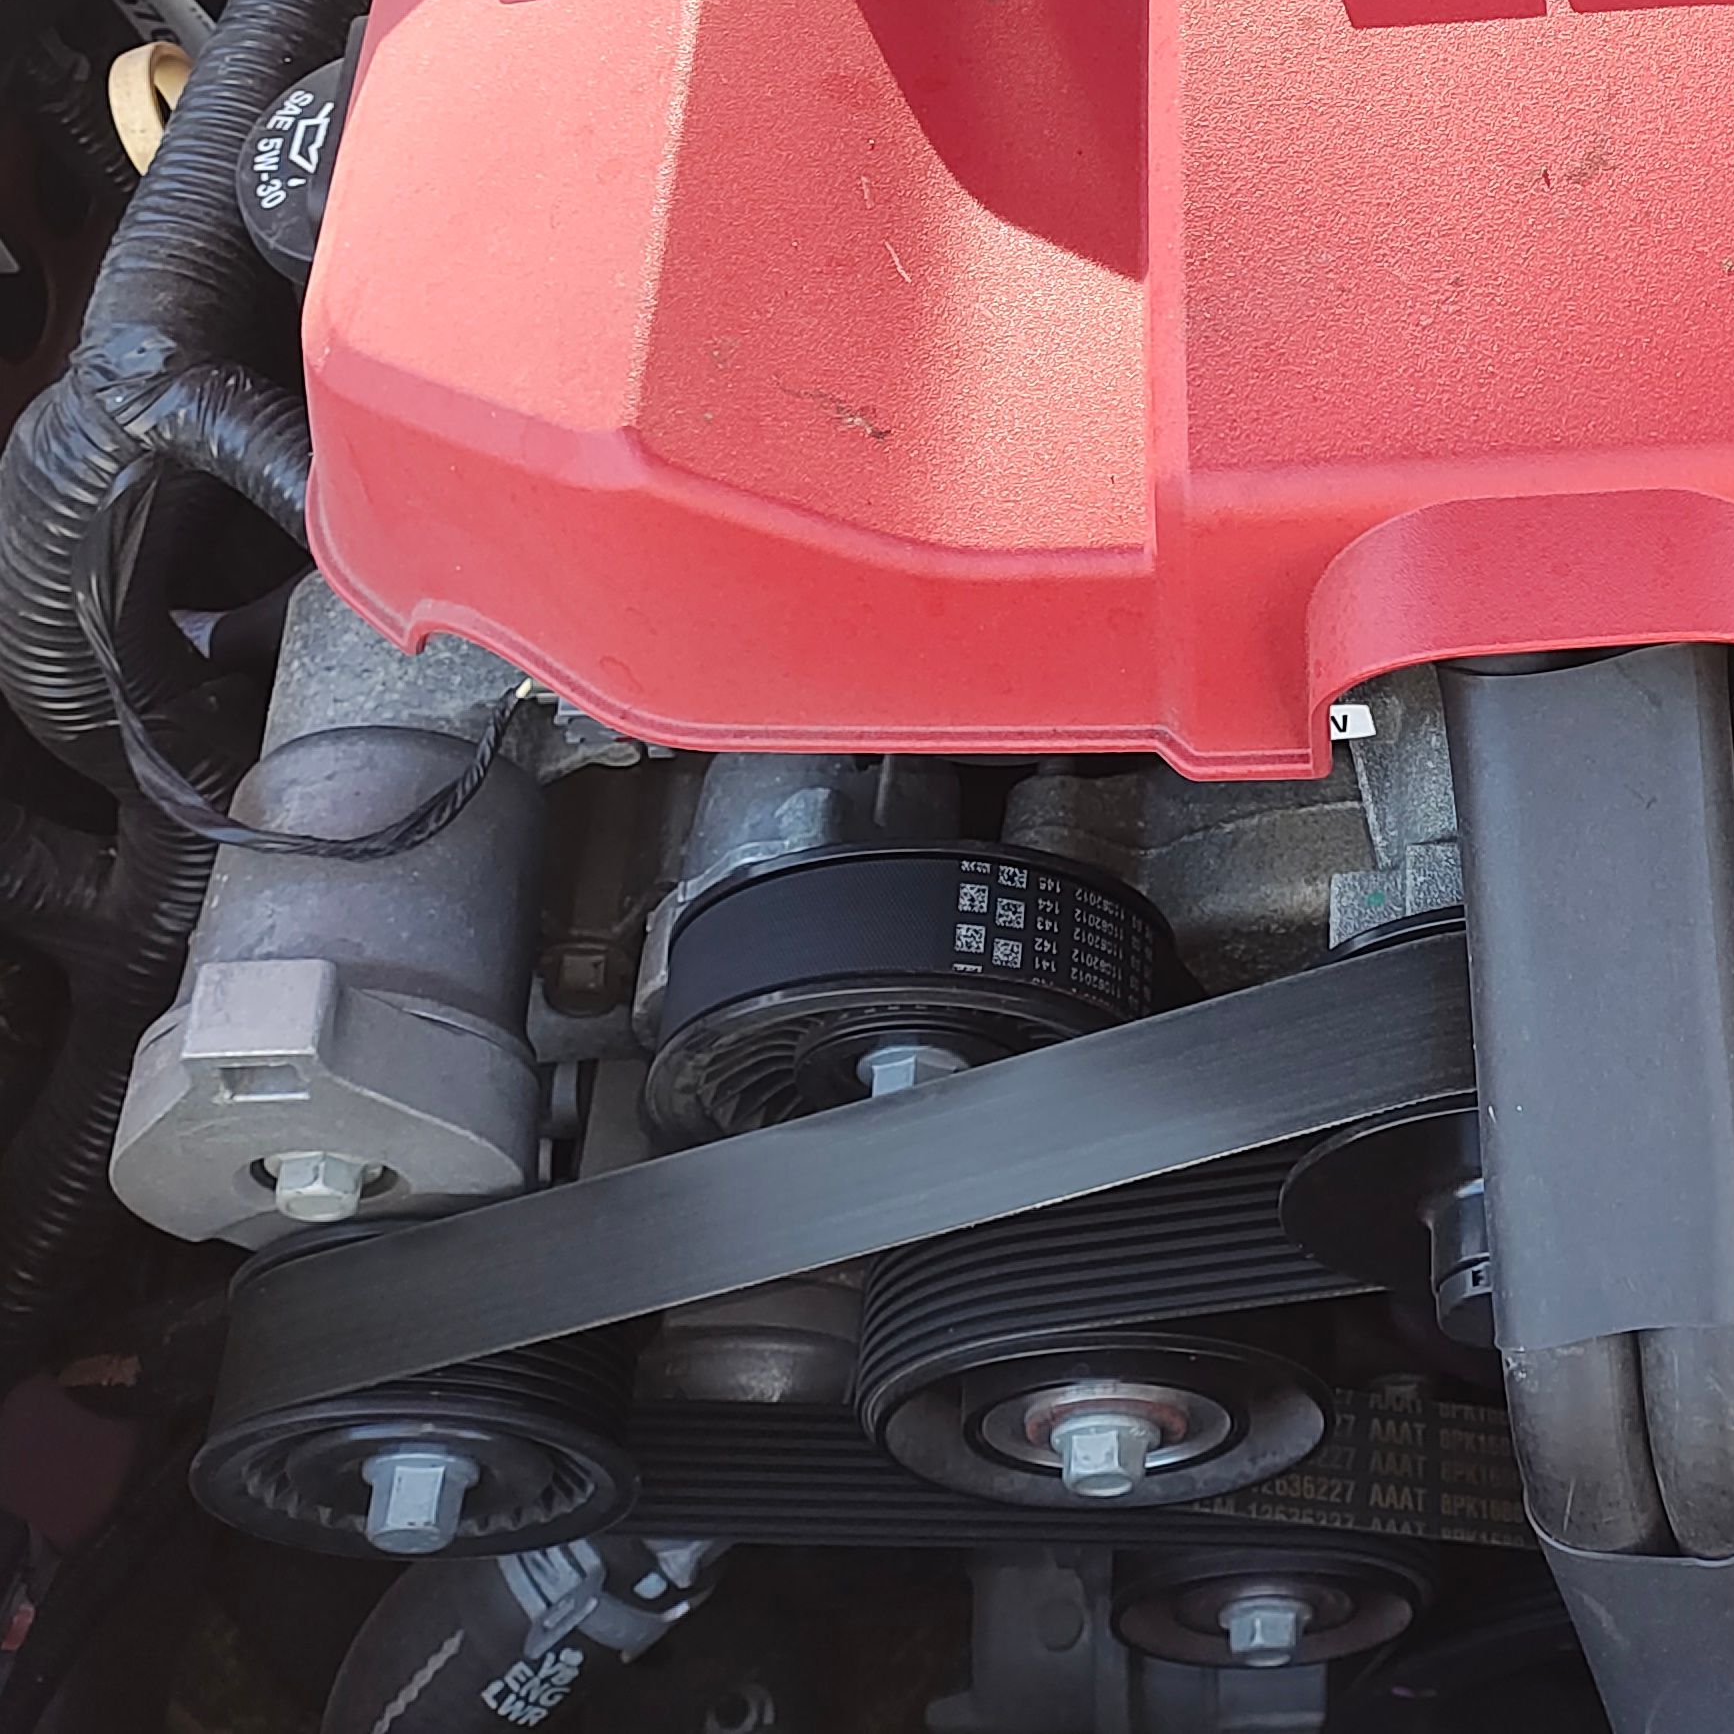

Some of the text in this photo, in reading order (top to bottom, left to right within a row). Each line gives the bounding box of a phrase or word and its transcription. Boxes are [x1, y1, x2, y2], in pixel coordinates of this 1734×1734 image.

[253, 89, 315, 209] SAE 5W-30
[1038, 877, 1061, 894] 145
[1037, 897, 1060, 914] 144
[1036, 917, 1059, 933] 143
[1034, 937, 1057, 954] 142
[1034, 956, 1056, 972] 141
[1368, 1483, 1427, 1513] AAAT
[504, 1660, 571, 1707] ENG
[481, 1679, 549, 1727] LWR
